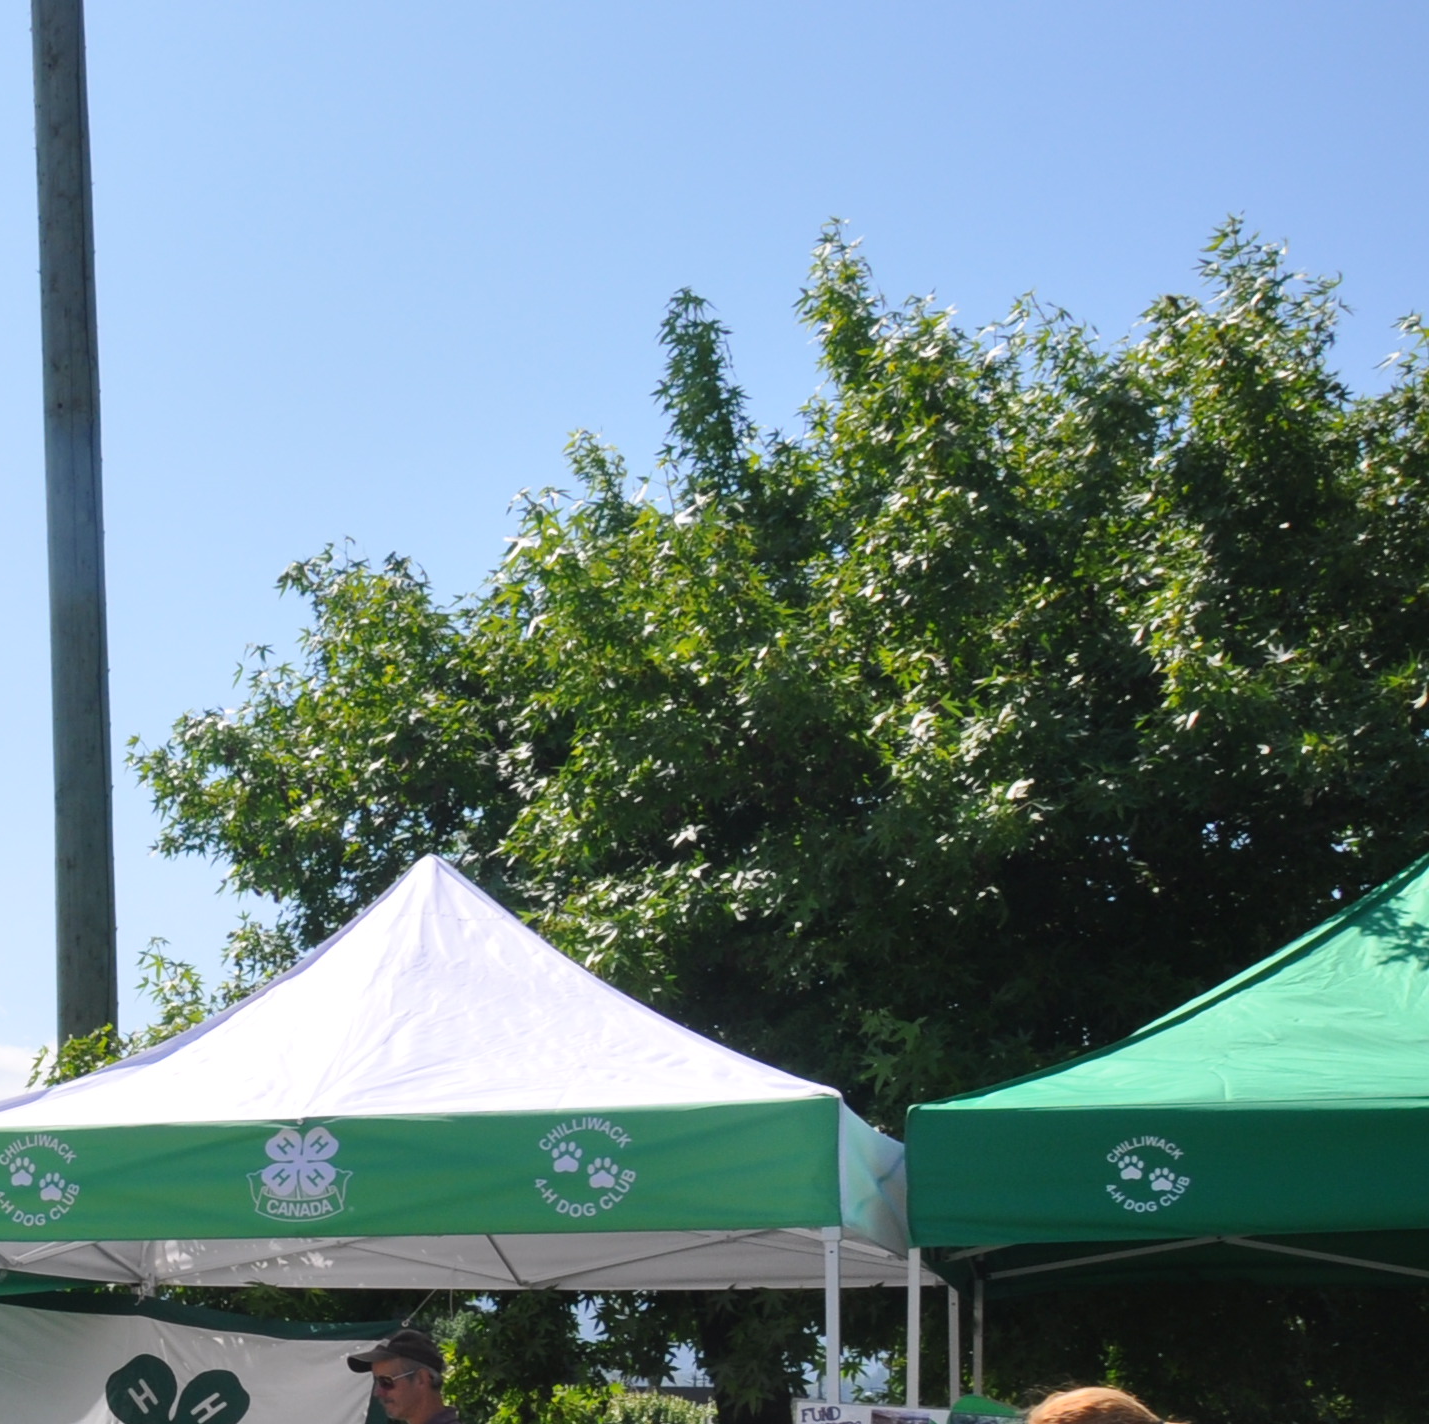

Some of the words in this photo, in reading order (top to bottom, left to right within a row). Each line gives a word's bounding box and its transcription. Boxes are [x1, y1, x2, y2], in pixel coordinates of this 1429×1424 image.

[538, 1116, 632, 1151] CHILLIWACK
[1106, 1135, 1184, 1163] CHILLIWACK
[12, 1210, 46, 1227] DOG
[49, 1183, 80, 1220] CLUB
[266, 1199, 334, 1218] CANADA
[534, 1178, 558, 1204] 4-H
[555, 1199, 597, 1218] DOG
[599, 1169, 637, 1210] CLUB
[1105, 1184, 1126, 1203] 4-H
[1123, 1199, 1158, 1213] DOG
[1159, 1176, 1191, 1207] CLUB
[801, 1406, 841, 1424] FUND
